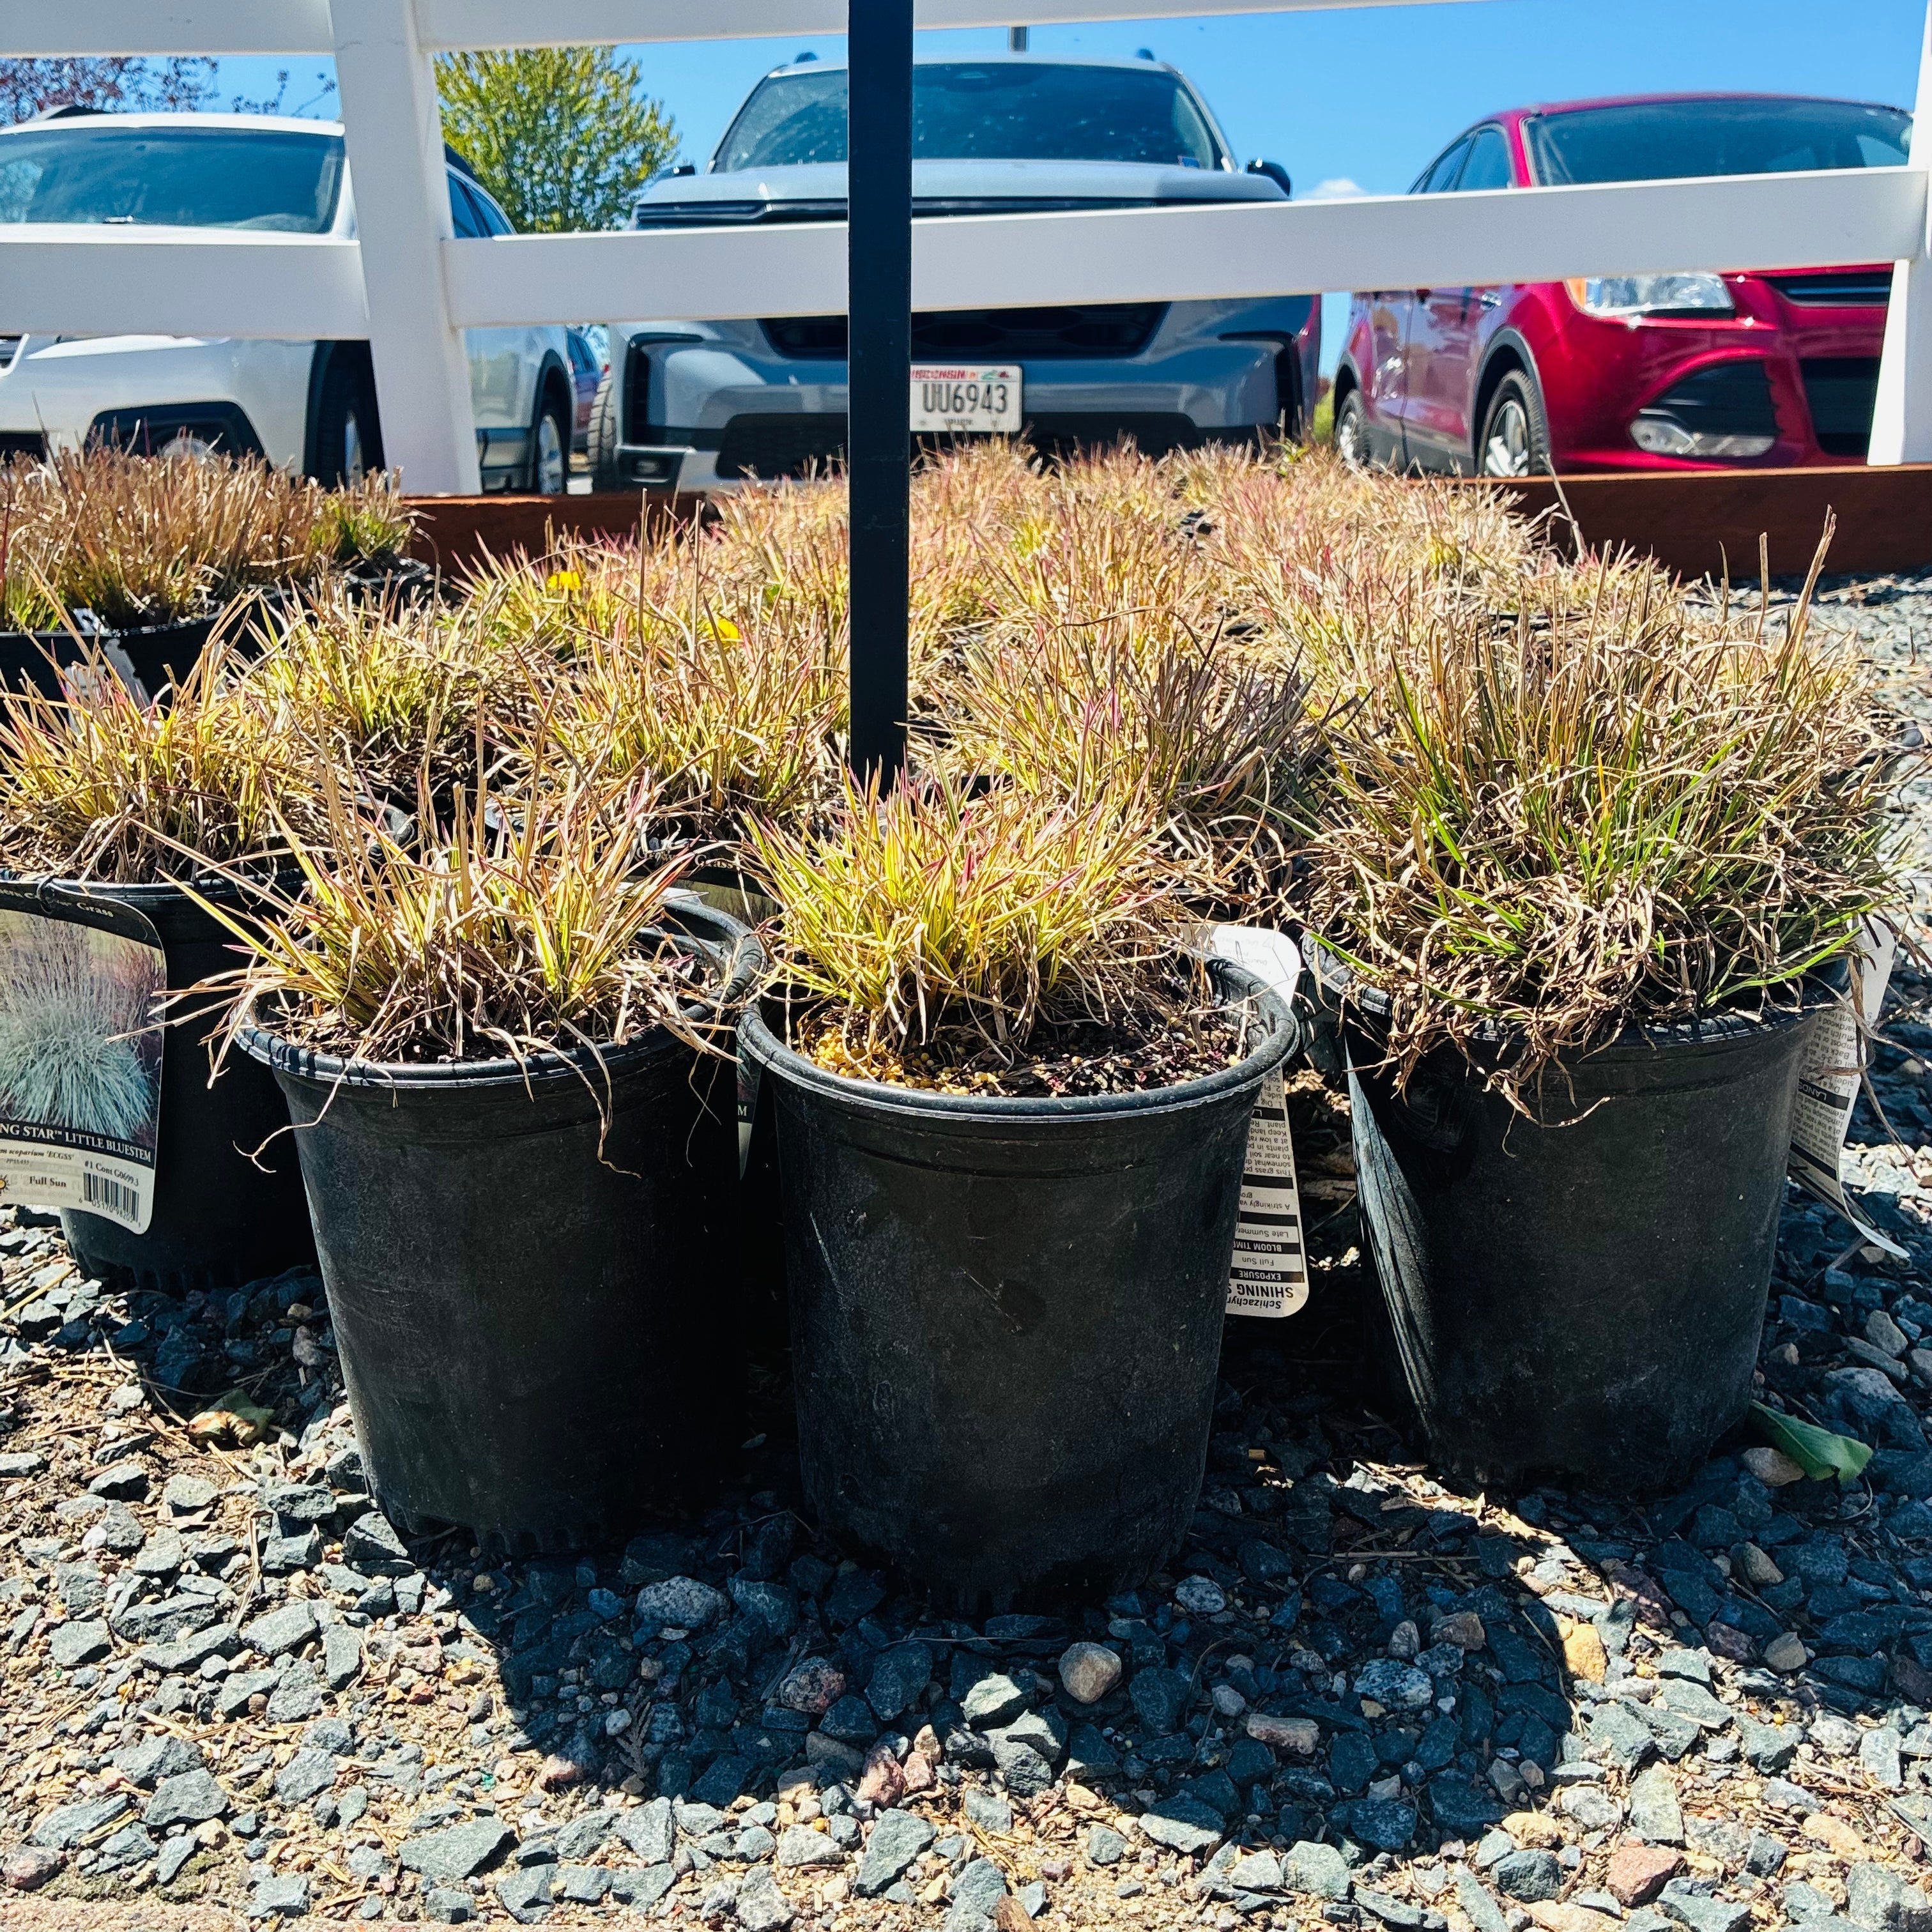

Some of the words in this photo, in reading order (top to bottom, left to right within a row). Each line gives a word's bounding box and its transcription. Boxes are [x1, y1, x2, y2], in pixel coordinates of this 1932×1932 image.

[923, 384, 1008, 413] UU6943
[77, 902, 114, 917] Grass
[1830, 1048, 1850, 1059] Back
[1828, 1082, 1840, 1093] Dig
[1261, 1098, 1273, 1107] Dig
[1820, 1104, 1845, 1119] Remove
[1268, 1129, 1287, 1137] Keep
[65, 1131, 105, 1149] LITTLE
[106, 1139, 151, 1162] BLUESTEM
[96, 1163, 112, 1176] Cont
[29, 1176, 47, 1184] Full
[50, 1177, 66, 1187] Sun
[1250, 1200, 1282, 1209] strikingly
[1238, 1229, 1269, 1237] Summer
[1254, 1243, 1282, 1252] BLOOM
[1238, 1271, 1281, 1280] EXPOSURE
[1237, 1284, 1293, 1298] SHINING
[1227, 1296, 1282, 1309] Schizachyr
